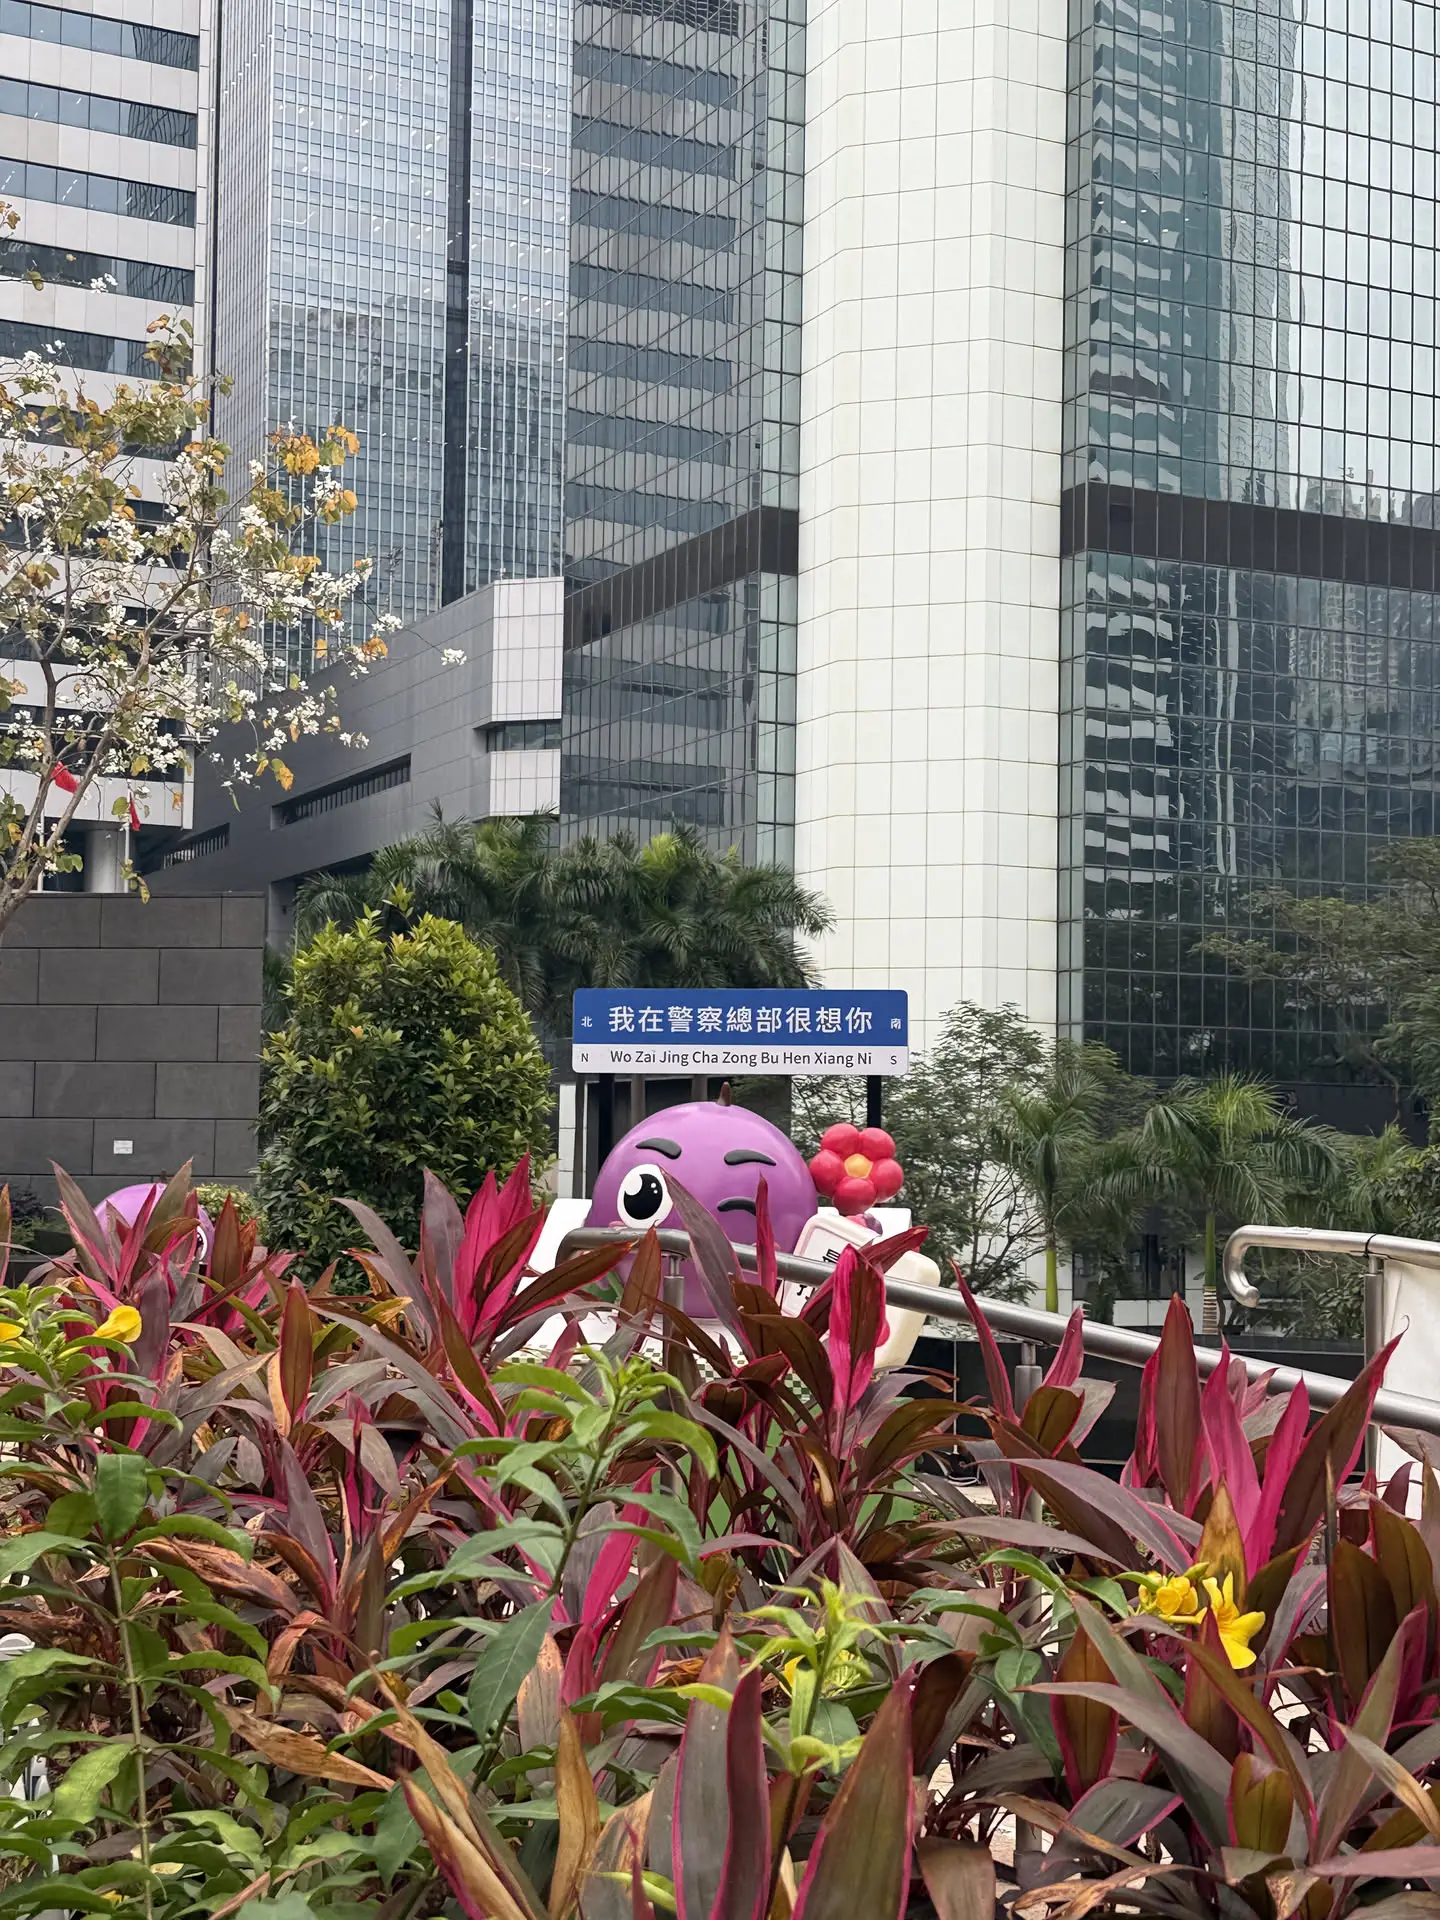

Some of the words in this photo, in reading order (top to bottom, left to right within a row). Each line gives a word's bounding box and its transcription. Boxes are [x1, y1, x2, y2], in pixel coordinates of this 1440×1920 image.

[581, 1016, 593, 1028] 北
[608, 1005, 873, 1034] 我在警察總部很想你
[581, 1052, 590, 1063] N
[610, 1050, 632, 1063] Wo
[635, 1050, 656, 1063] Zai
[659, 1050, 689, 1067] Jing
[692, 1050, 719, 1064] Cha
[722, 1051, 758, 1067] Zong
[761, 1051, 779, 1065] Bu
[783, 1052, 811, 1065] Hen
[814, 1051, 854, 1068] Xiang
[857, 1052, 872, 1065] Ni
[890, 1055, 897, 1065] S
